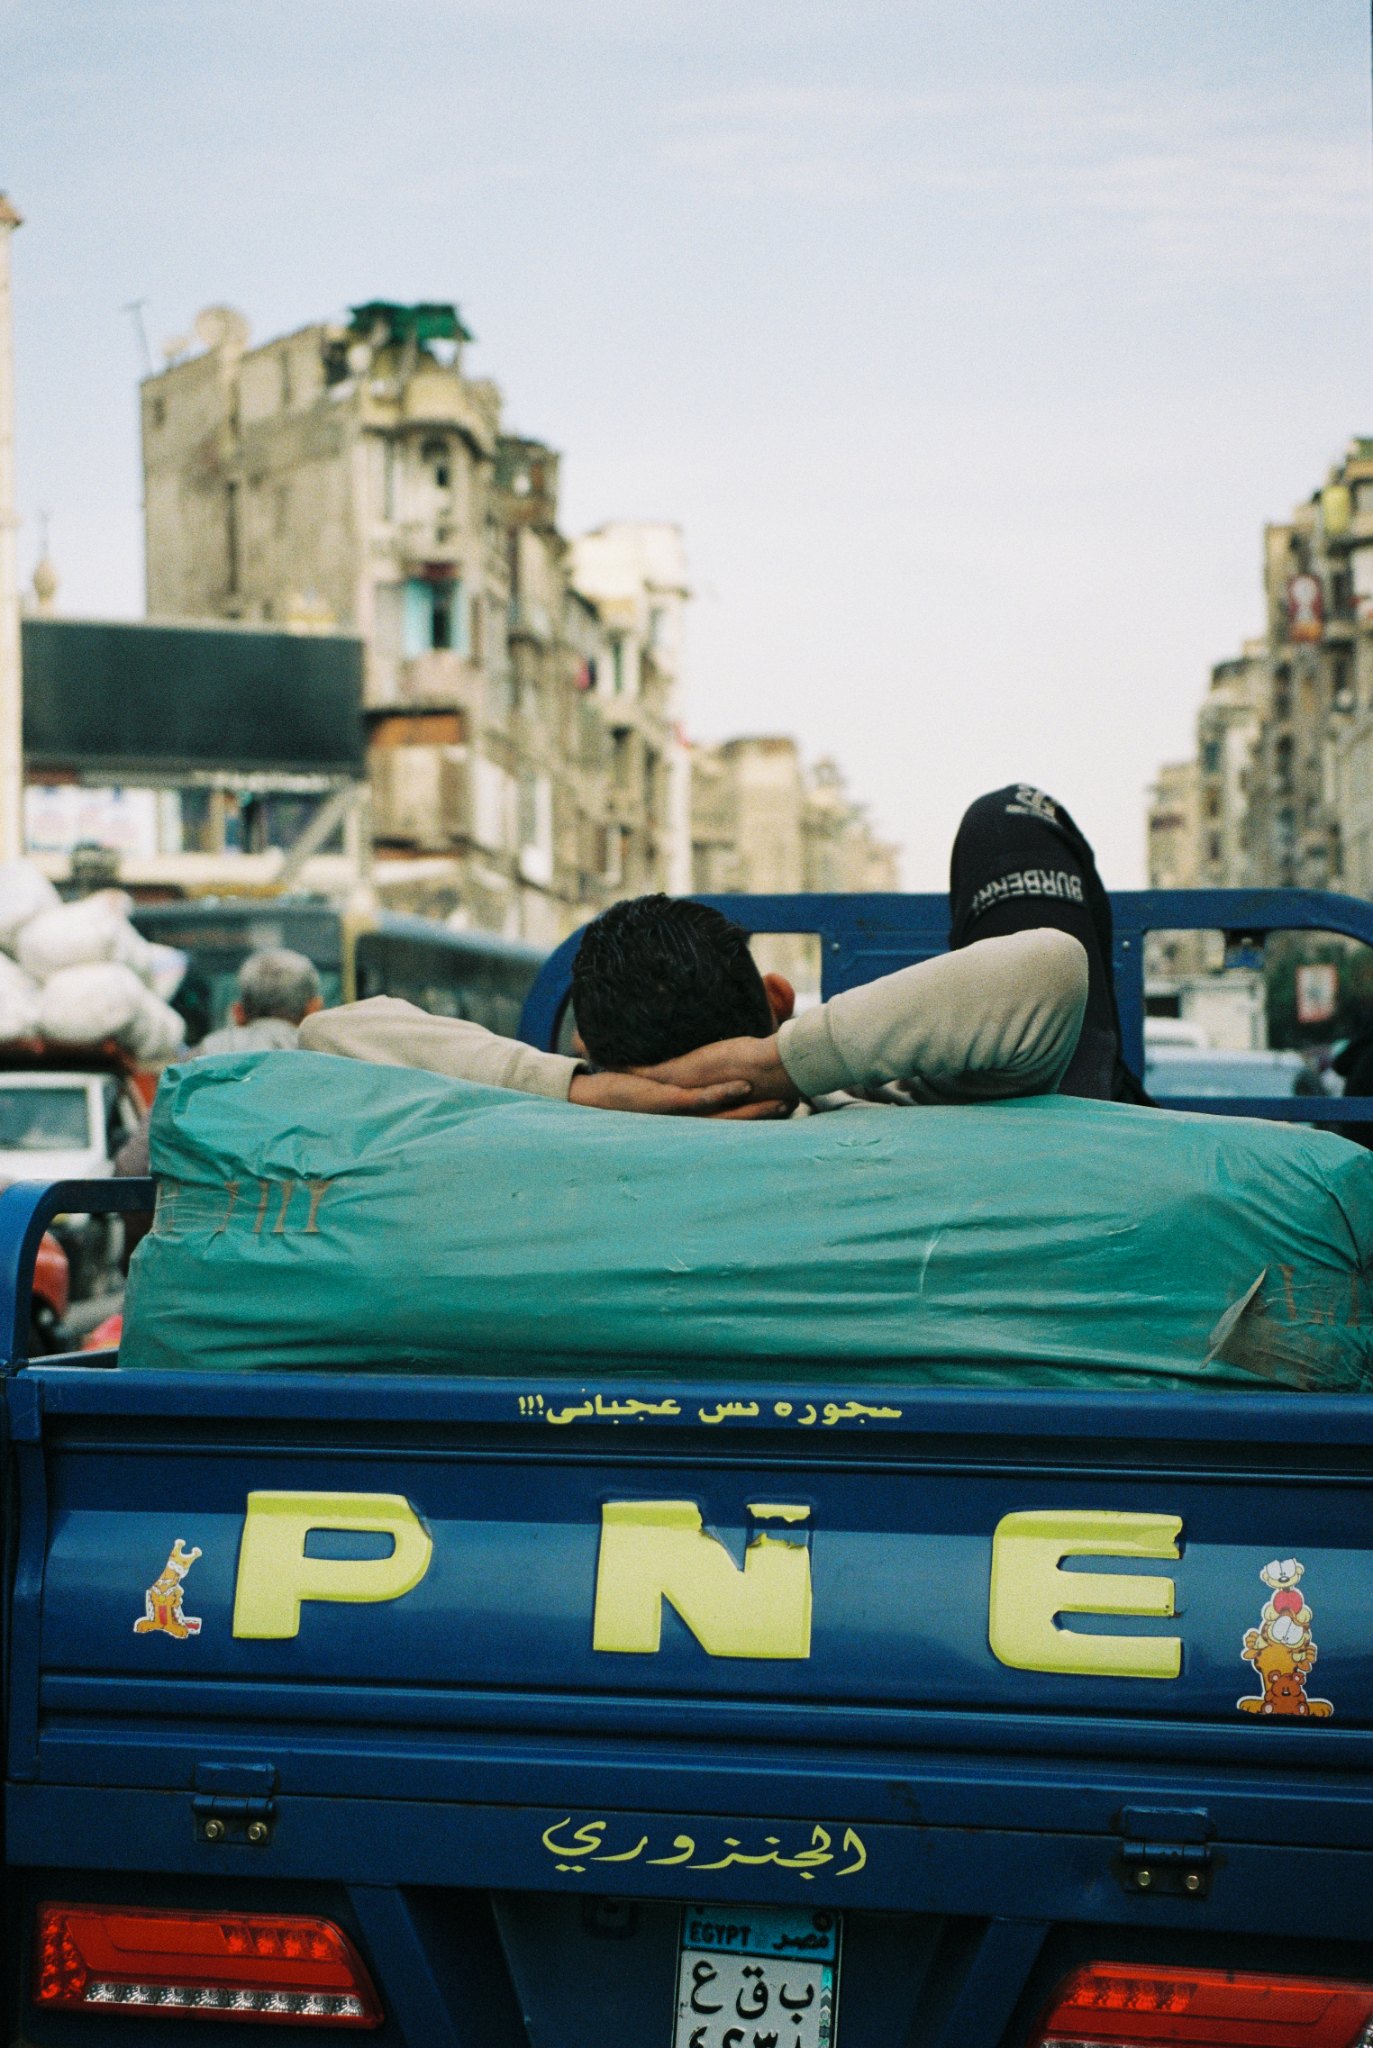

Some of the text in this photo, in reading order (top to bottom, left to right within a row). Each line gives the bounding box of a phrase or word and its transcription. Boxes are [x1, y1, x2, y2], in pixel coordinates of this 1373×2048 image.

[542, 1817, 867, 1880] الجنزوري
[689, 1920, 751, 1947] EGYPT
[772, 1932, 830, 1950] مصر
